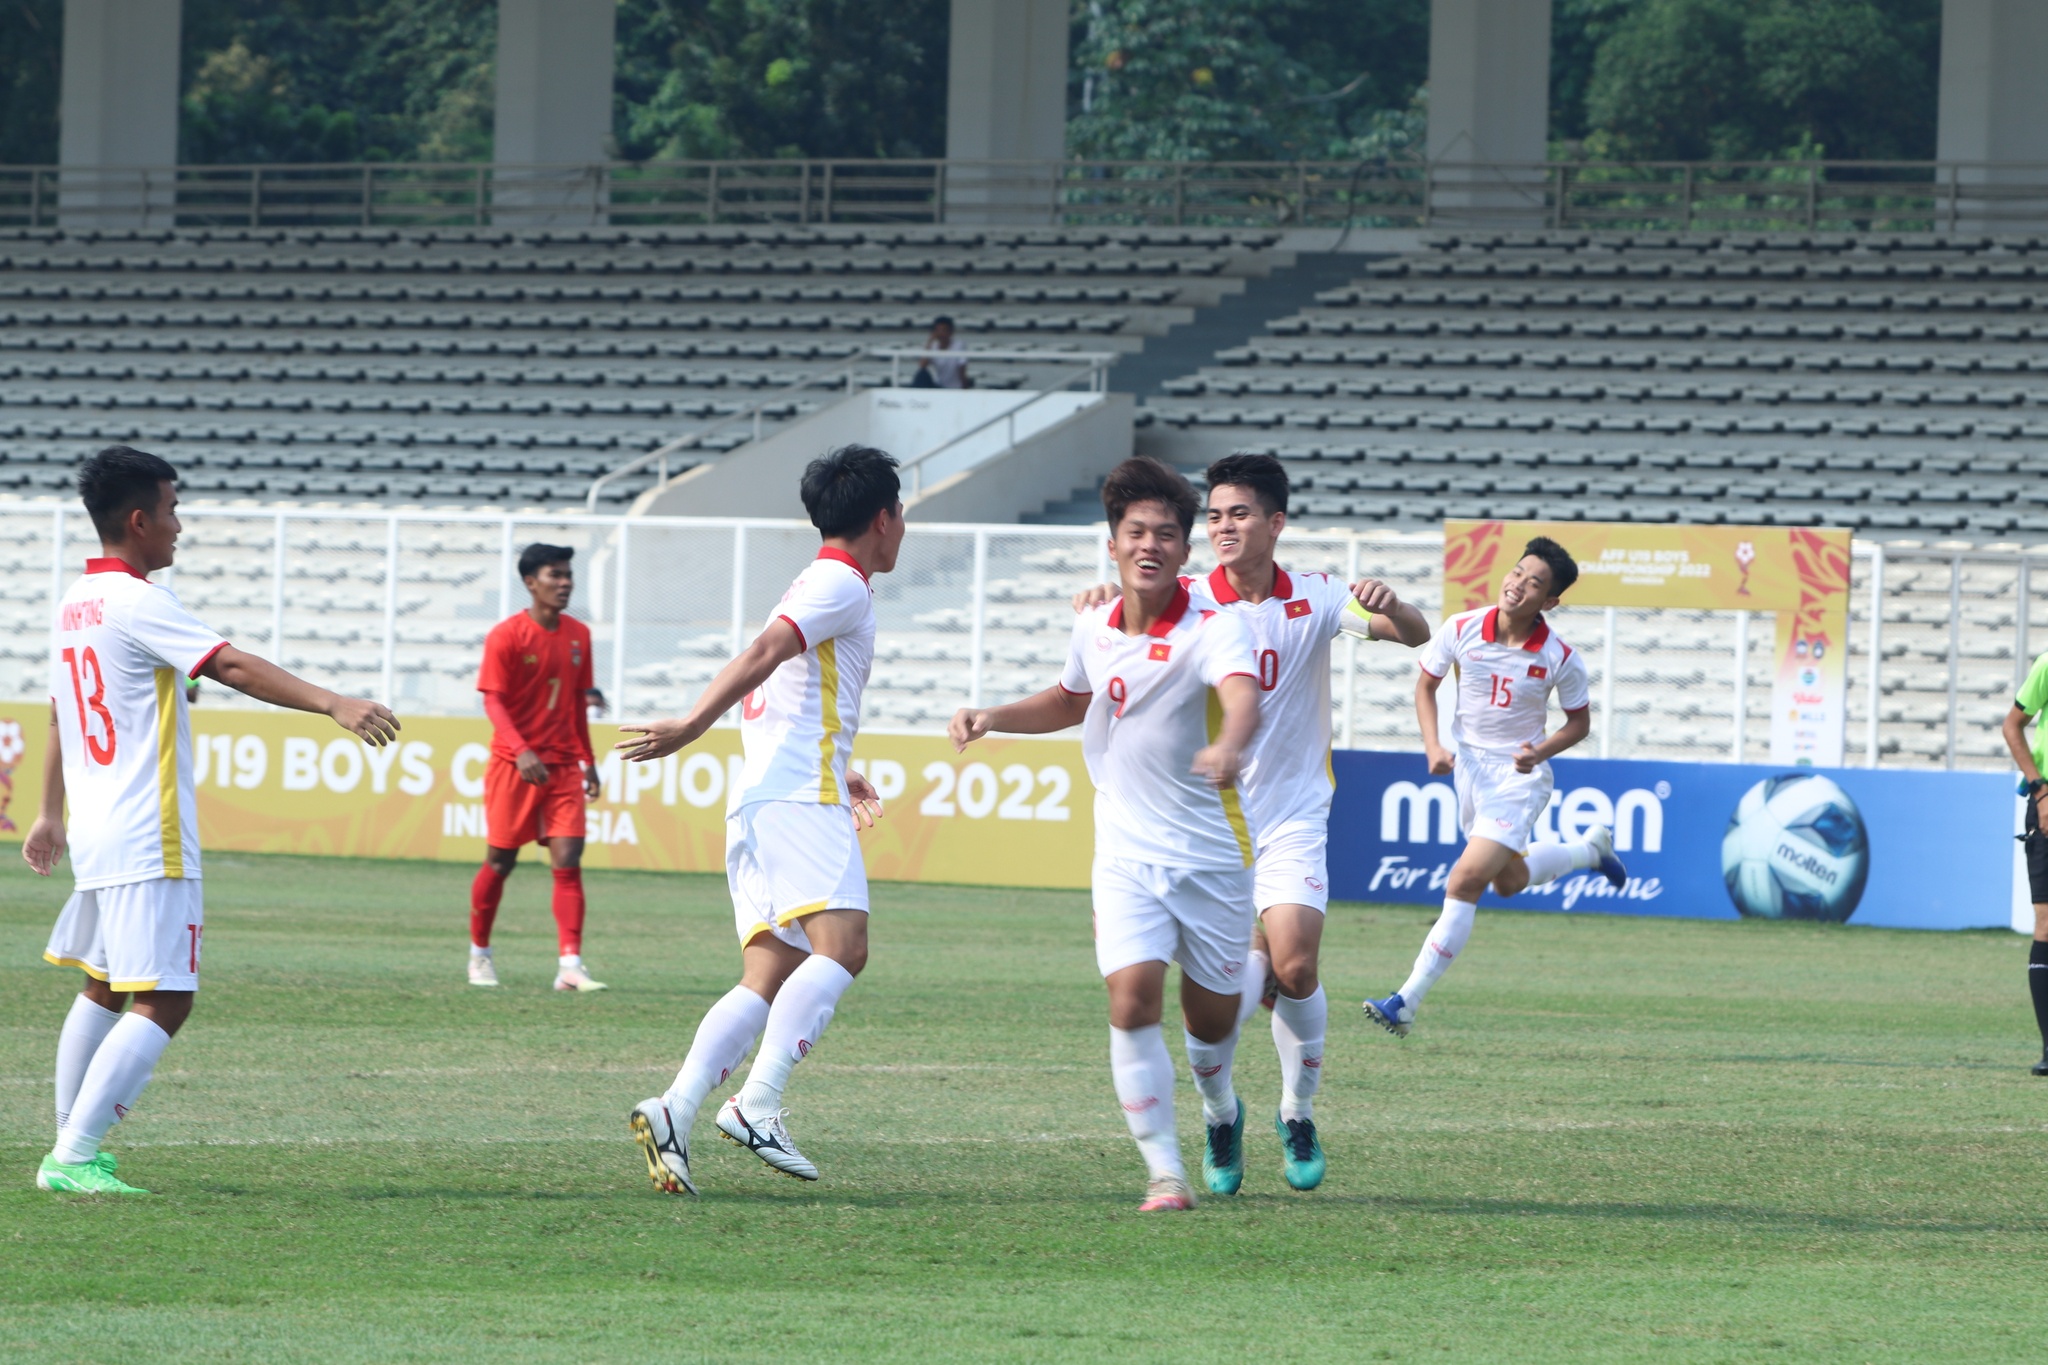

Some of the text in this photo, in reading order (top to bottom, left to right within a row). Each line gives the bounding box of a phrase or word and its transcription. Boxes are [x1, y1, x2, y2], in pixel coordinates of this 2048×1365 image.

[1600, 549, 1625, 561] AFF
[1654, 550, 1690, 563] BOYS
[1678, 563, 1711, 577] 2022
[62, 645, 117, 767] 13
[547, 678, 561, 710] 7
[1109, 676, 1127, 719] 9
[1490, 673, 1514, 708] 15
[282, 737, 434, 796] BOYS
[919, 761, 1071, 821] 2022
[1368, 855, 1428, 892] For
[1562, 874, 1664, 910] game
[1776, 843, 1838, 886] molten
